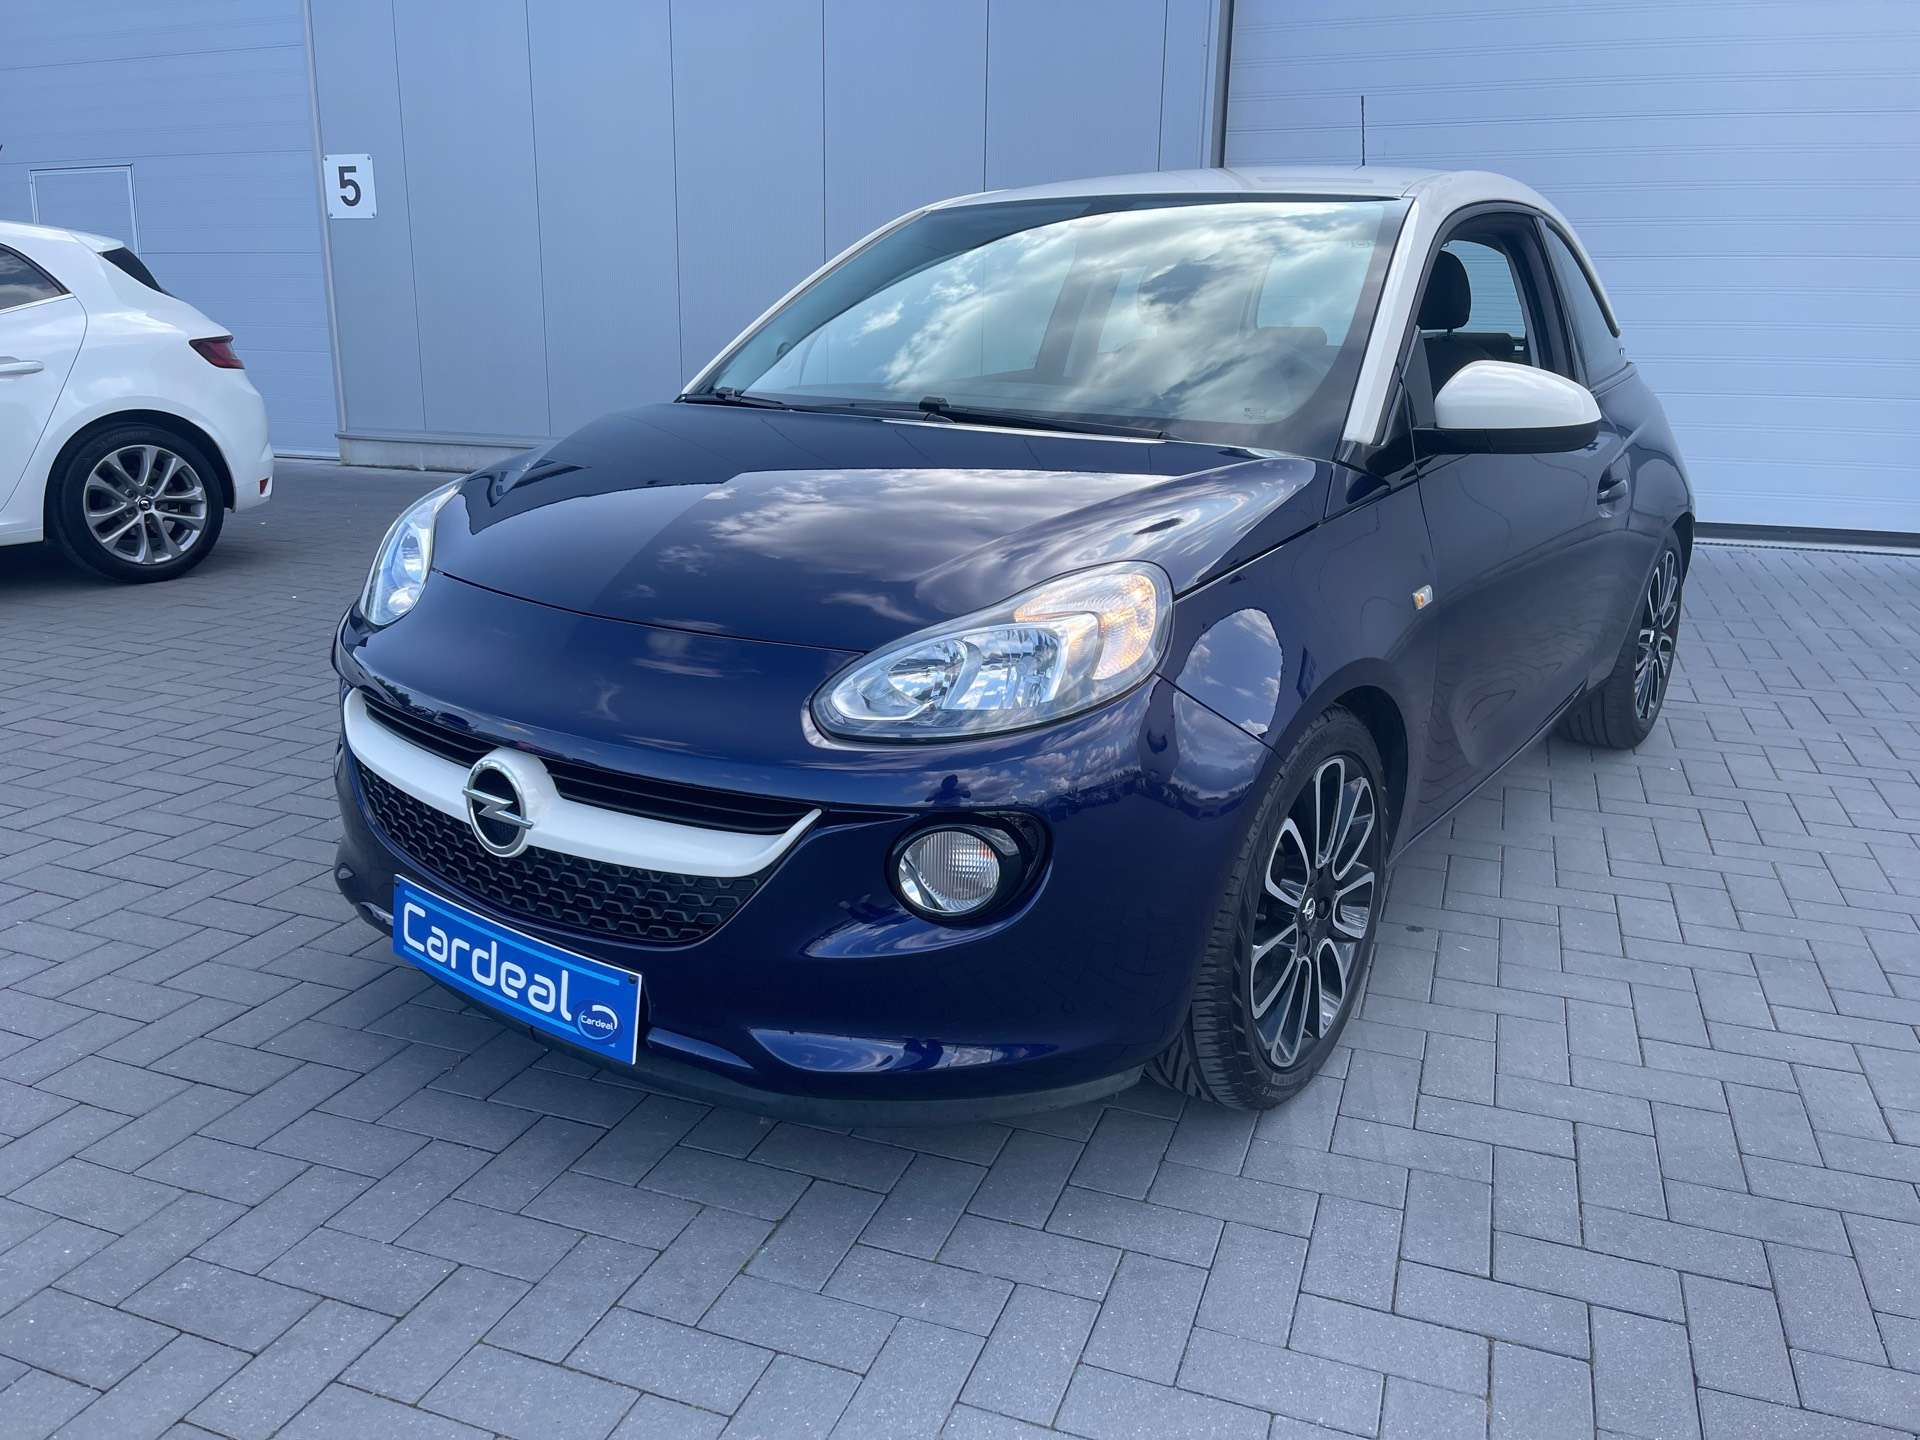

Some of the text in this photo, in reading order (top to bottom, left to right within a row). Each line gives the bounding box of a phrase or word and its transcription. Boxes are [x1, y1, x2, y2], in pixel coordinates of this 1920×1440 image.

[338, 166, 361, 206] 5
[403, 902, 572, 1021] Cardeal
[580, 1015, 614, 1031] Cardeal
